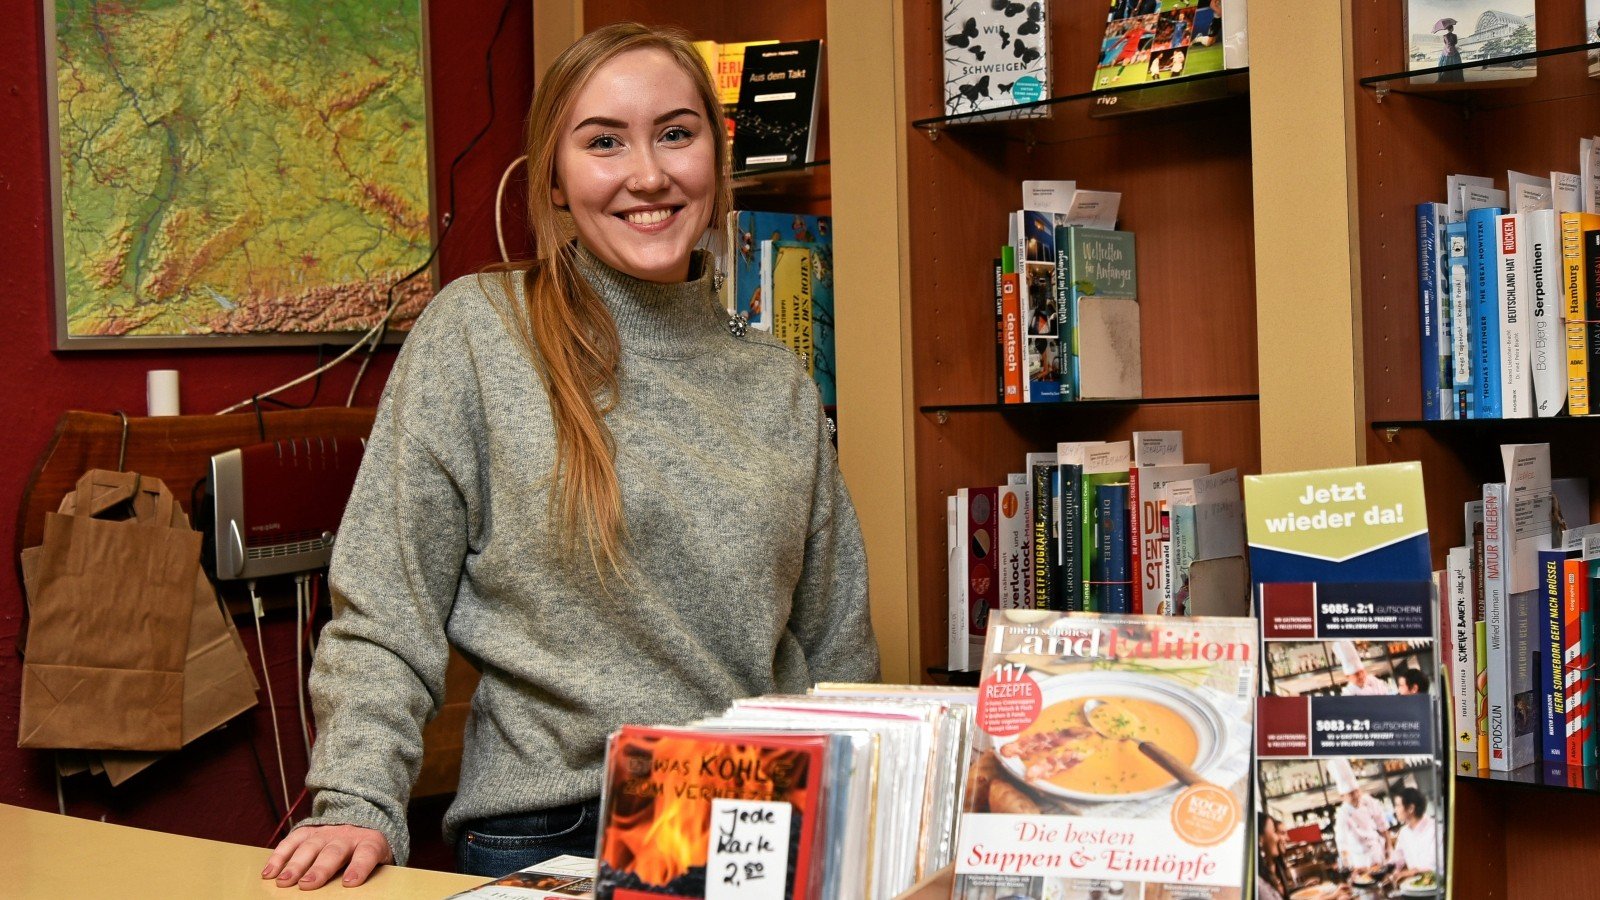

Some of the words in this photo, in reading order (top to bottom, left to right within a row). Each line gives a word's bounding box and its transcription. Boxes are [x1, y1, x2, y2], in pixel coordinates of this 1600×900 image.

[750, 73, 765, 82] Aus
[767, 72, 786, 81] dem
[788, 69, 806, 78] Takt
[963, 62, 1027, 75] SCHWEIGEN
[1097, 95, 1117, 106] riva
[1504, 222, 1514, 250] RÜCKEN
[1082, 241, 1122, 262] Weltretten
[1506, 258, 1515, 272] HAT
[801, 256, 809, 295] ROTEN
[1533, 244, 1546, 317] Serpentinen
[1569, 264, 1580, 314] Hamburg
[1506, 274, 1516, 324] DEUTSCHLAND
[1007, 313, 1017, 372] deutsch
[1480, 316, 1488, 363] PLETZINGER
[1536, 322, 1548, 348] Bjerg
[1536, 351, 1546, 371] Bov
[1298, 481, 1367, 506] Jetzt
[1266, 508, 1356, 534] wieder
[1363, 502, 1404, 527] da!
[1486, 496, 1498, 540] ERLEBEN
[1486, 544, 1499, 580] NATUR
[1546, 560, 1558, 596] BRÜSSEL
[1321, 603, 1350, 615] 5085
[1356, 602, 1374, 614] 2:1
[1376, 605, 1422, 614] GUTSCHEINE
[1490, 590, 1499, 621] Stichmann
[1548, 598, 1558, 618] NACH
[992, 625, 1100, 658] Land
[1108, 627, 1250, 661] Edition
[1009, 624, 1038, 636] mein
[1490, 622, 1500, 650] Wilfried
[1550, 620, 1560, 640] GEHT
[993, 663, 1026, 684] 117
[1552, 642, 1562, 690] SONNEBORN
[986, 684, 1032, 698] REZEPTE
[1554, 692, 1564, 714] HERR
[1352, 720, 1370, 731] 2:1
[1492, 705, 1502, 749] PODSZUN
[721, 808, 776, 839] Jede
[1015, 823, 1058, 843] Die
[1064, 824, 1135, 846] besten
[967, 844, 1062, 873] Suppen
[1070, 846, 1097, 868] &
[1102, 850, 1217, 882] Eintöpfe
